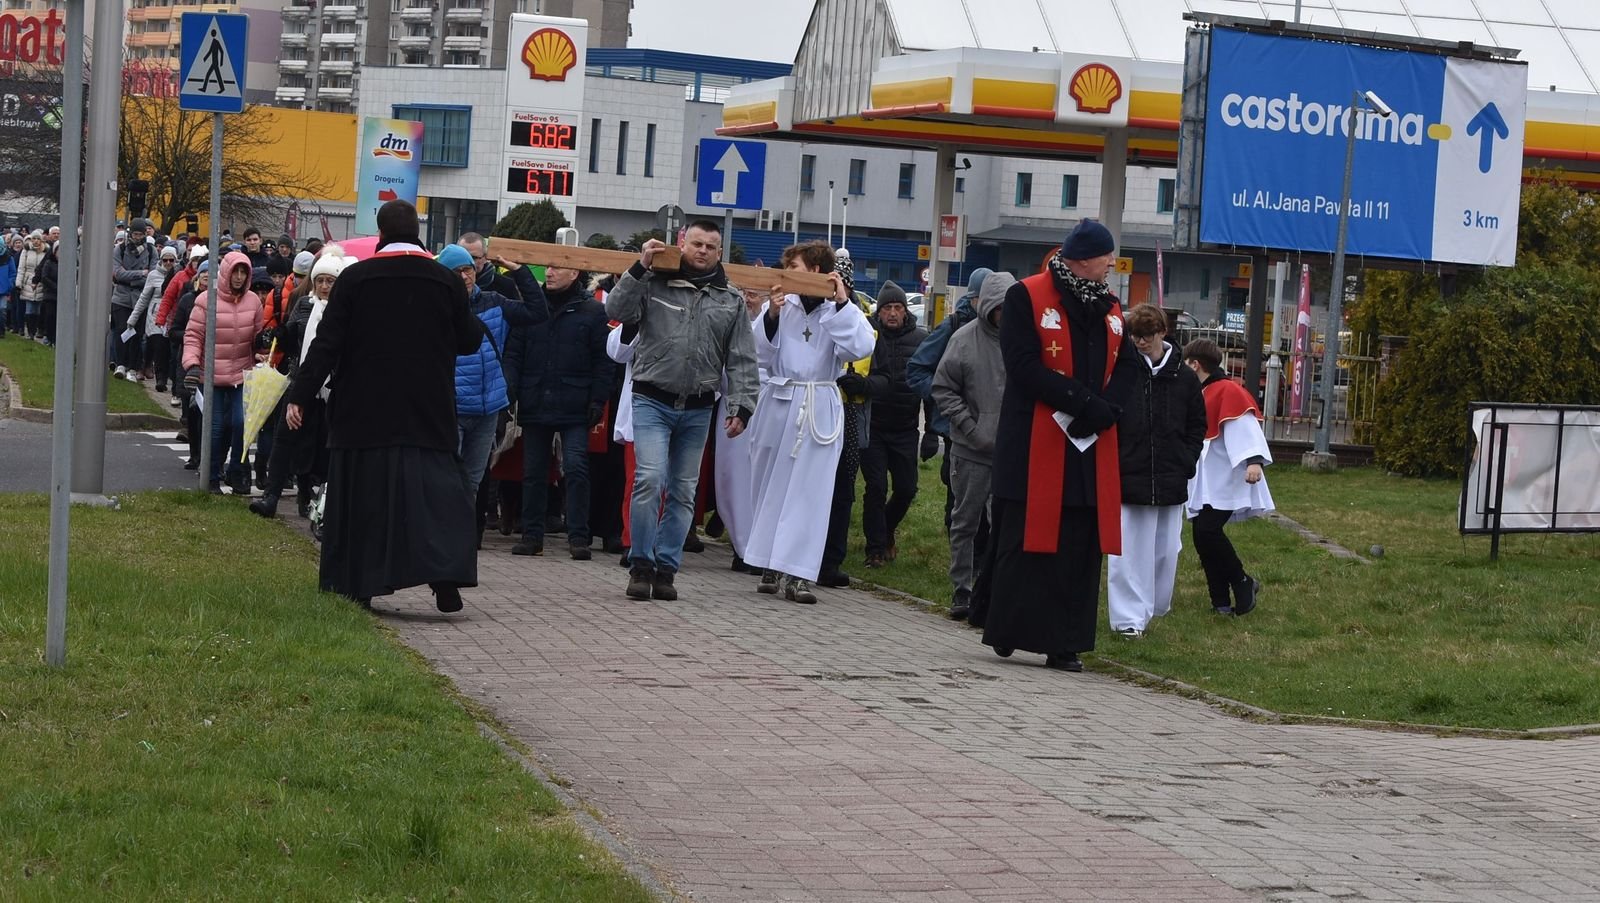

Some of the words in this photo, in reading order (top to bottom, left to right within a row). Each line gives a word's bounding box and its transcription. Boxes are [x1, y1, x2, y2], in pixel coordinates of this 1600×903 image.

[0, 9, 65, 77] gat
[515, 113, 547, 122] FuelSave
[1221, 93, 1424, 146] castorama
[380, 133, 408, 150] dm
[530, 122, 571, 150] 6.82
[511, 159, 545, 169] FuelSave
[547, 162, 569, 170] Diesel
[374, 174, 404, 185] Drogeria
[526, 170, 568, 196] 6.71
[1232, 189, 1250, 208] ul.
[1377, 202, 1389, 220] 11
[1463, 210, 1472, 227] 3
[1476, 211, 1499, 229] km
[920, 248, 927, 257] 3
[1120, 261, 1128, 270] 2
